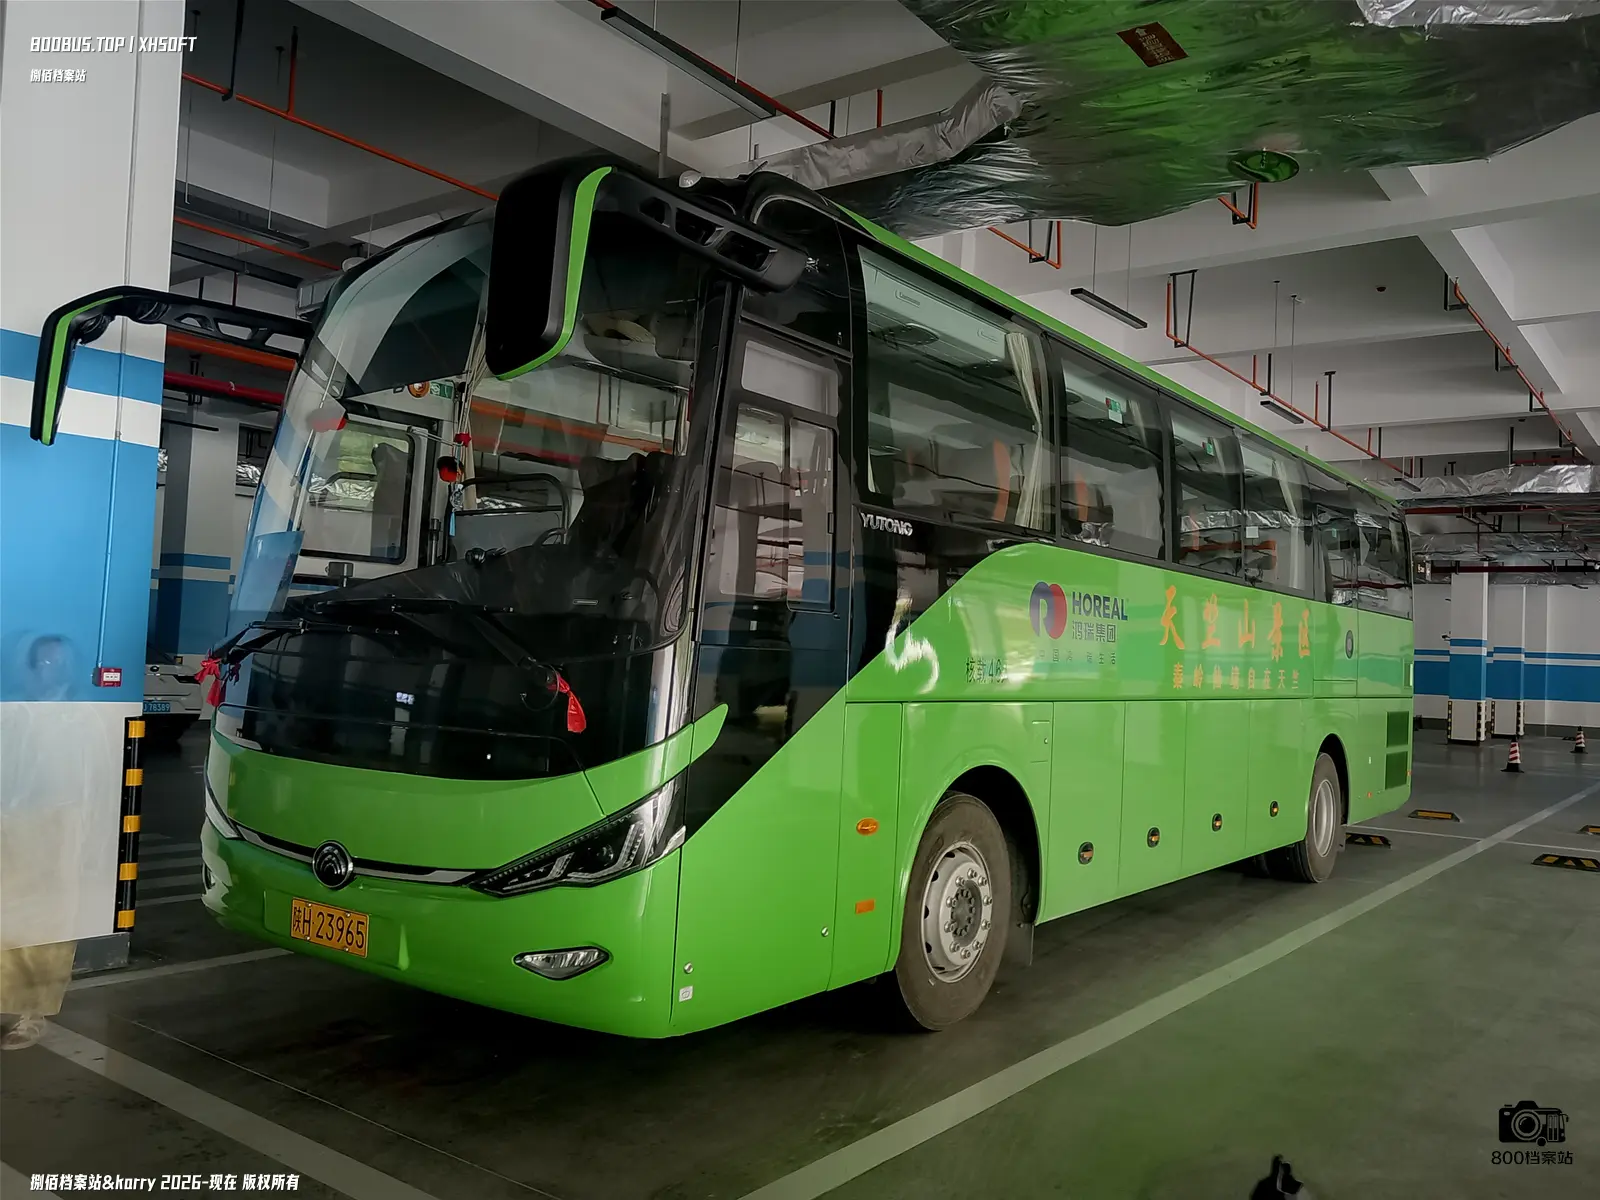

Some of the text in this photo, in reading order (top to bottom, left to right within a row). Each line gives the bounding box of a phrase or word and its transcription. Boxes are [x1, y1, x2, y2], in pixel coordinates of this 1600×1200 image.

[860, 512, 914, 537] YUTONG
[1072, 591, 1128, 621] HOREAL
[143, 702, 170, 712] J78389
